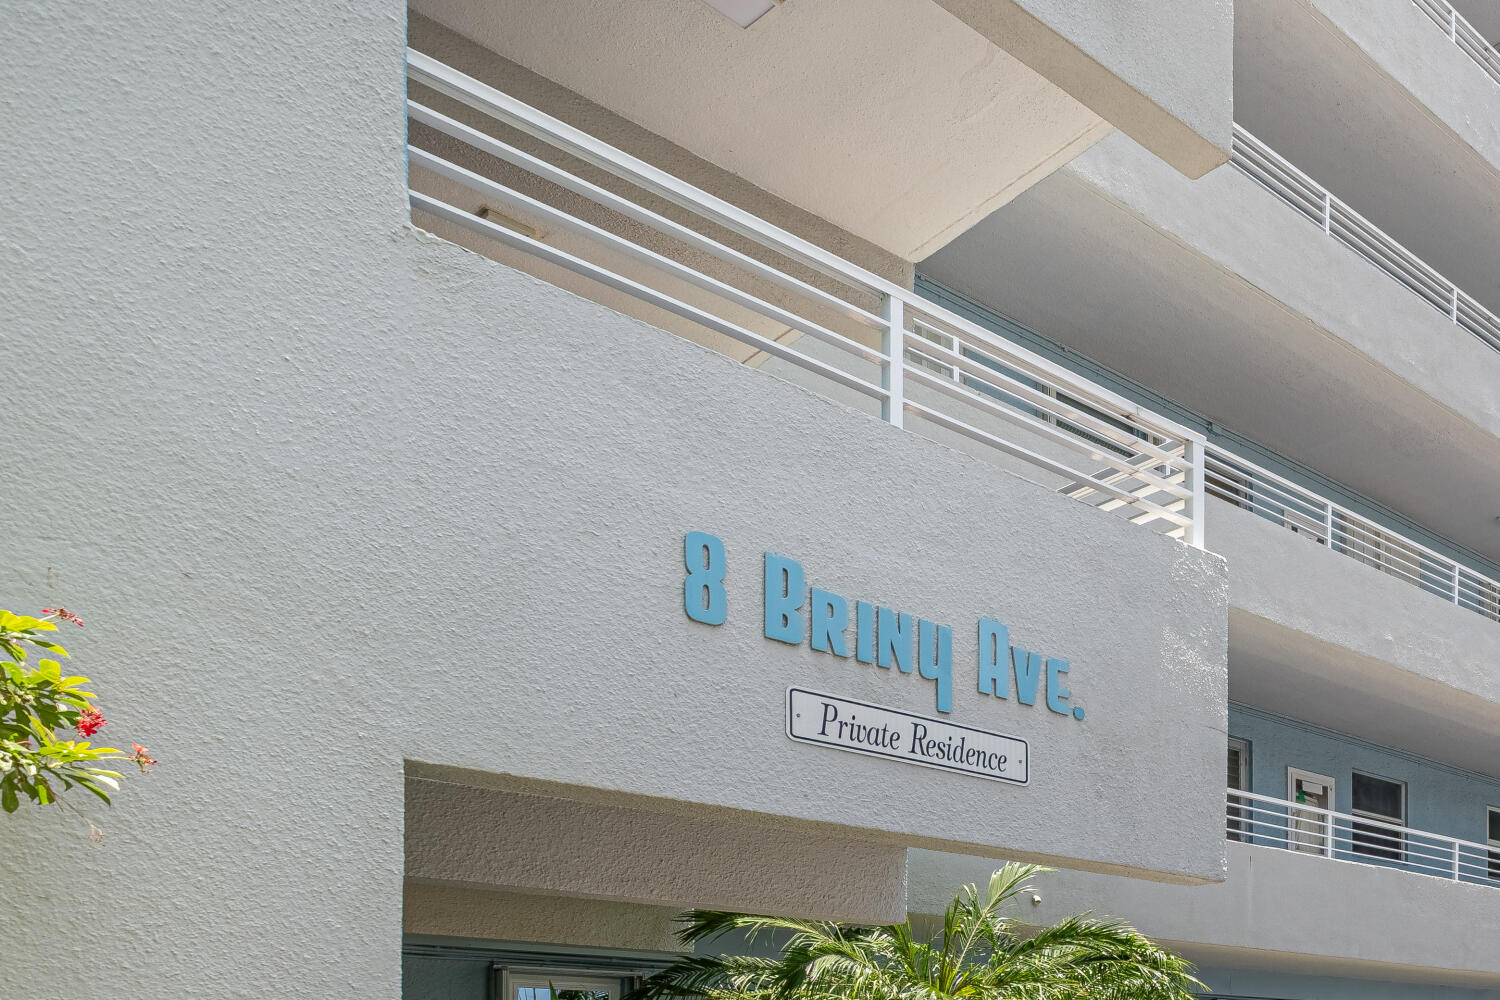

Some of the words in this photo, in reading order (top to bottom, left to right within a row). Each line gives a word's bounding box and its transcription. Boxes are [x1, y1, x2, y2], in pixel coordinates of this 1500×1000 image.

[684, 531, 727, 626] 8
[817, 702, 901, 751] Private
[907, 722, 1008, 773] Residence
